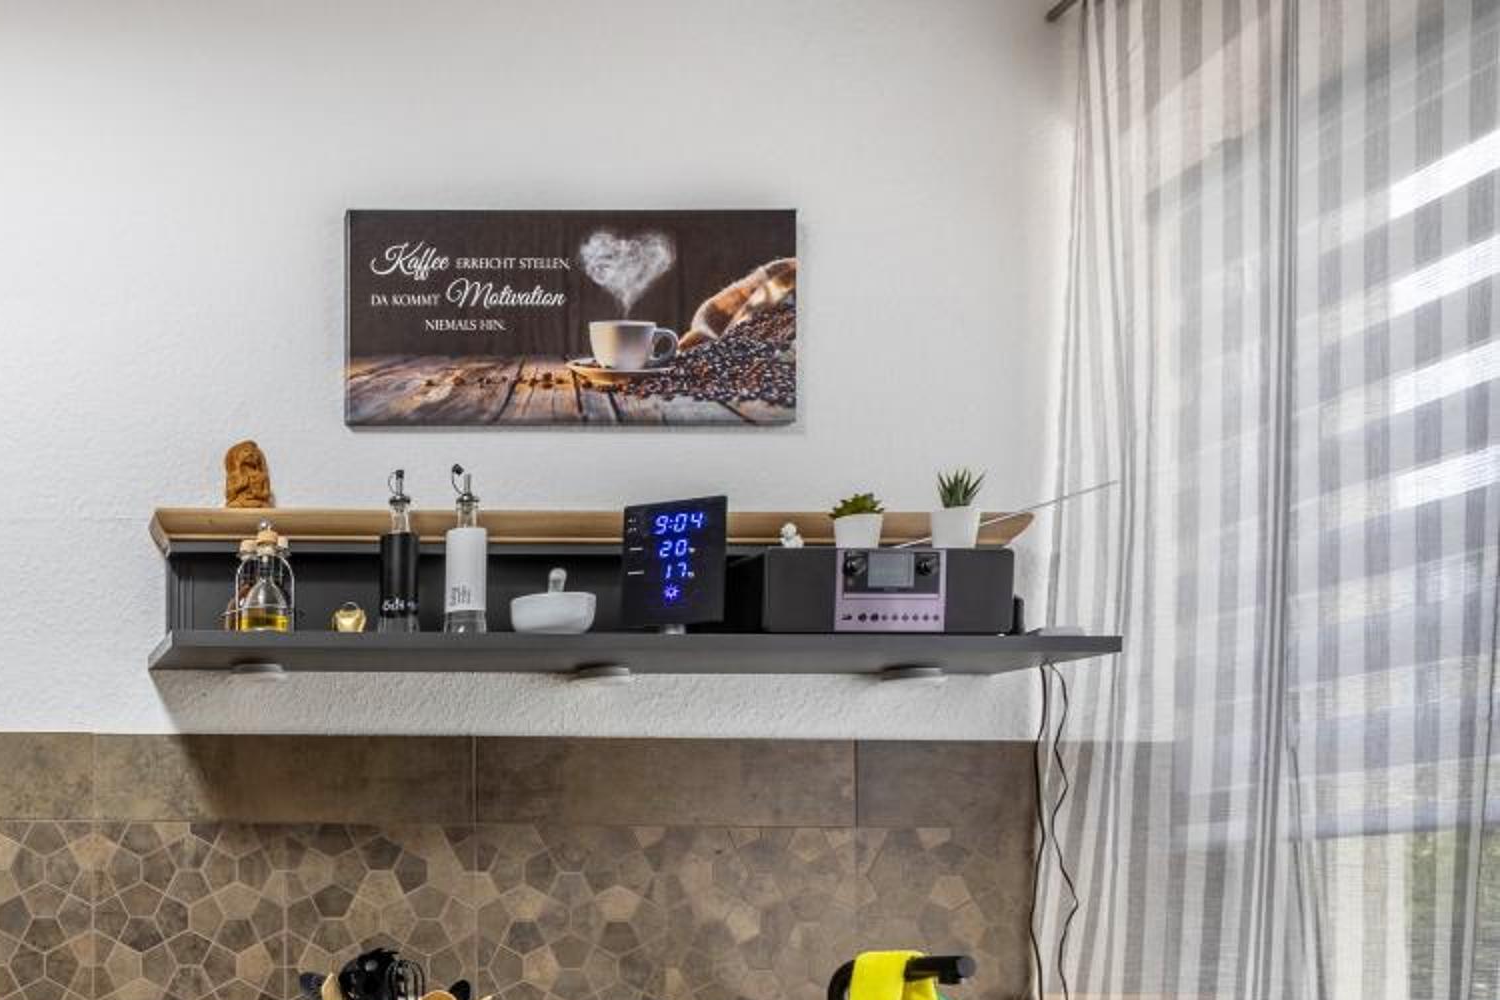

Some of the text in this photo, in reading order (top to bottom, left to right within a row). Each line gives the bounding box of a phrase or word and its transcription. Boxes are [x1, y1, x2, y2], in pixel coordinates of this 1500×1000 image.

[370, 240, 450, 280] Kaffee
[455, 257, 517, 269] ERREICHT
[371, 277, 565, 309] DA KOMMT Motivation
[425, 319, 477, 331] NIEMALS
[654, 513, 704, 535] 9:04
[659, 539, 688, 557] 20
